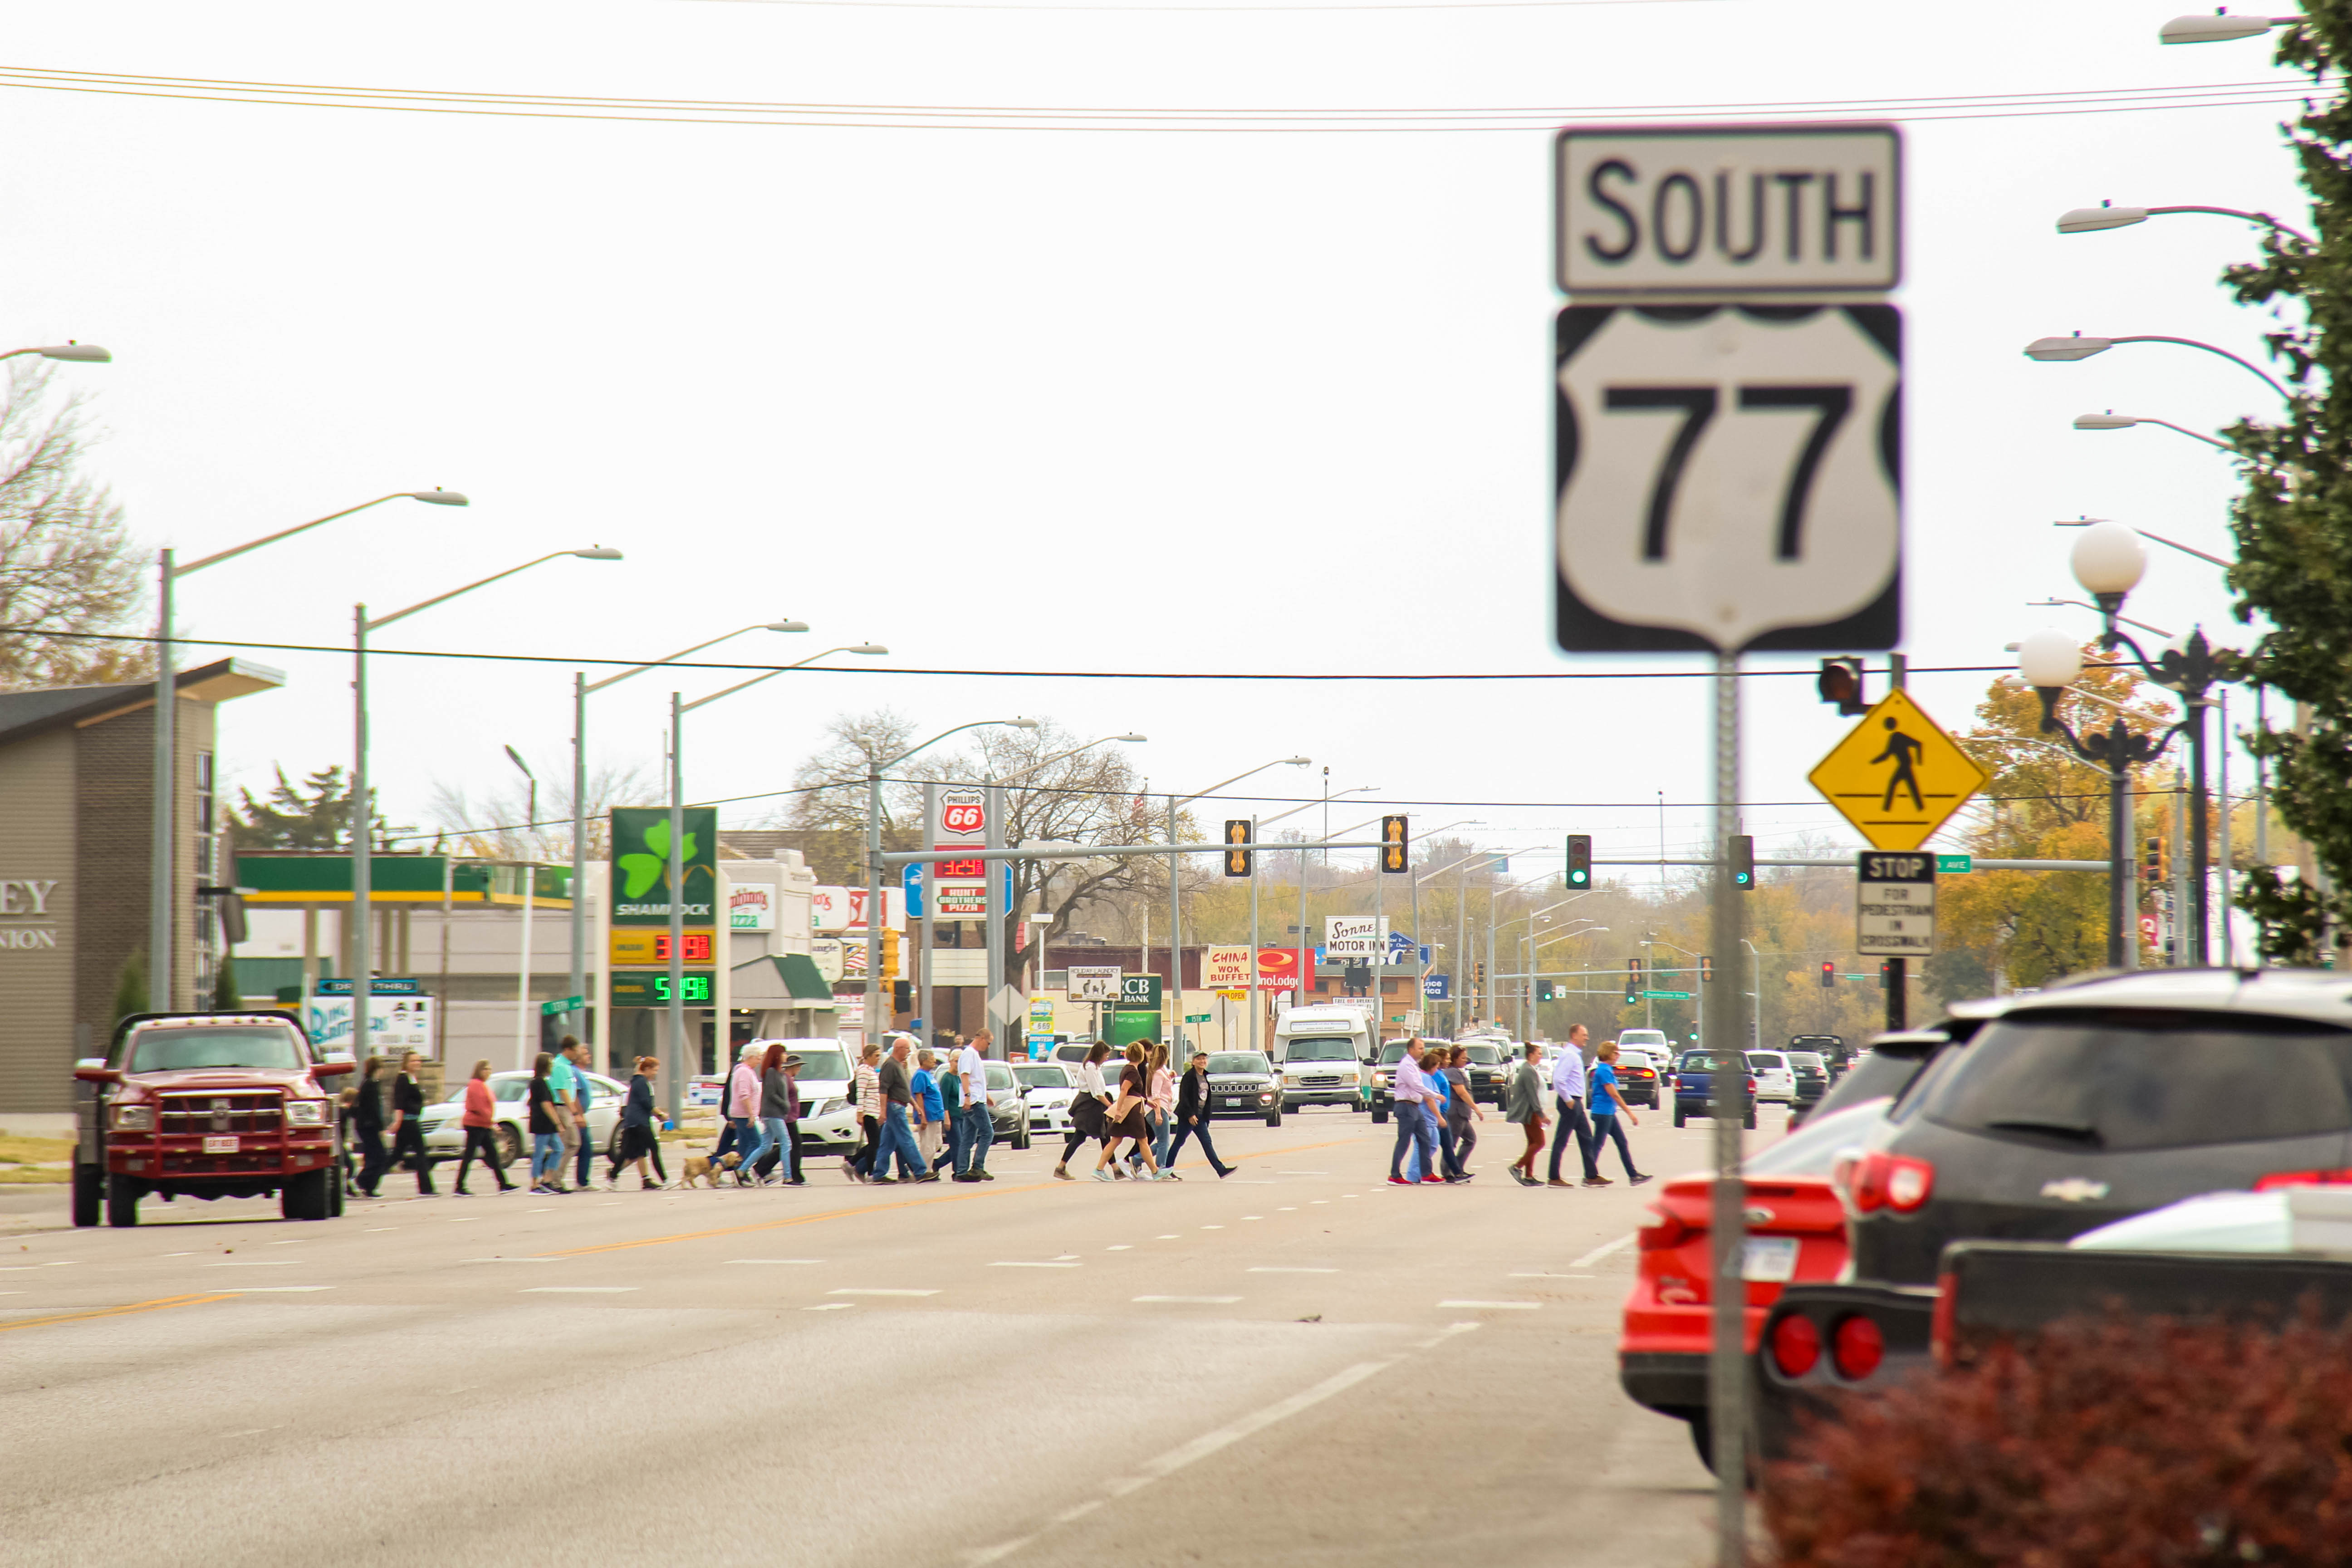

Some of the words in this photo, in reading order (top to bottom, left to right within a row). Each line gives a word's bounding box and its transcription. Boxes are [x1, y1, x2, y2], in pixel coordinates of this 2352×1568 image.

[1583, 157, 1876, 266] SOUTH
[1599, 383, 1857, 563] 77
[948, 808, 979, 826] 66
[1869, 857, 1925, 877] STOP
[1884, 889, 1908, 900] FOR
[615, 904, 711, 915] SHAMCK
[1862, 904, 1932, 916] PEDESTRIAN
[730, 910, 758, 927] izza
[1333, 921, 1382, 939] Sonne
[1889, 920, 1902, 931] IN
[1330, 941, 1364, 951] MOTOR
[1862, 936, 1930, 947] CROSSWALK
[1212, 952, 1248, 963] CHINA
[1210, 973, 1250, 981] BUFFET
[1260, 975, 1298, 988] noLodg
